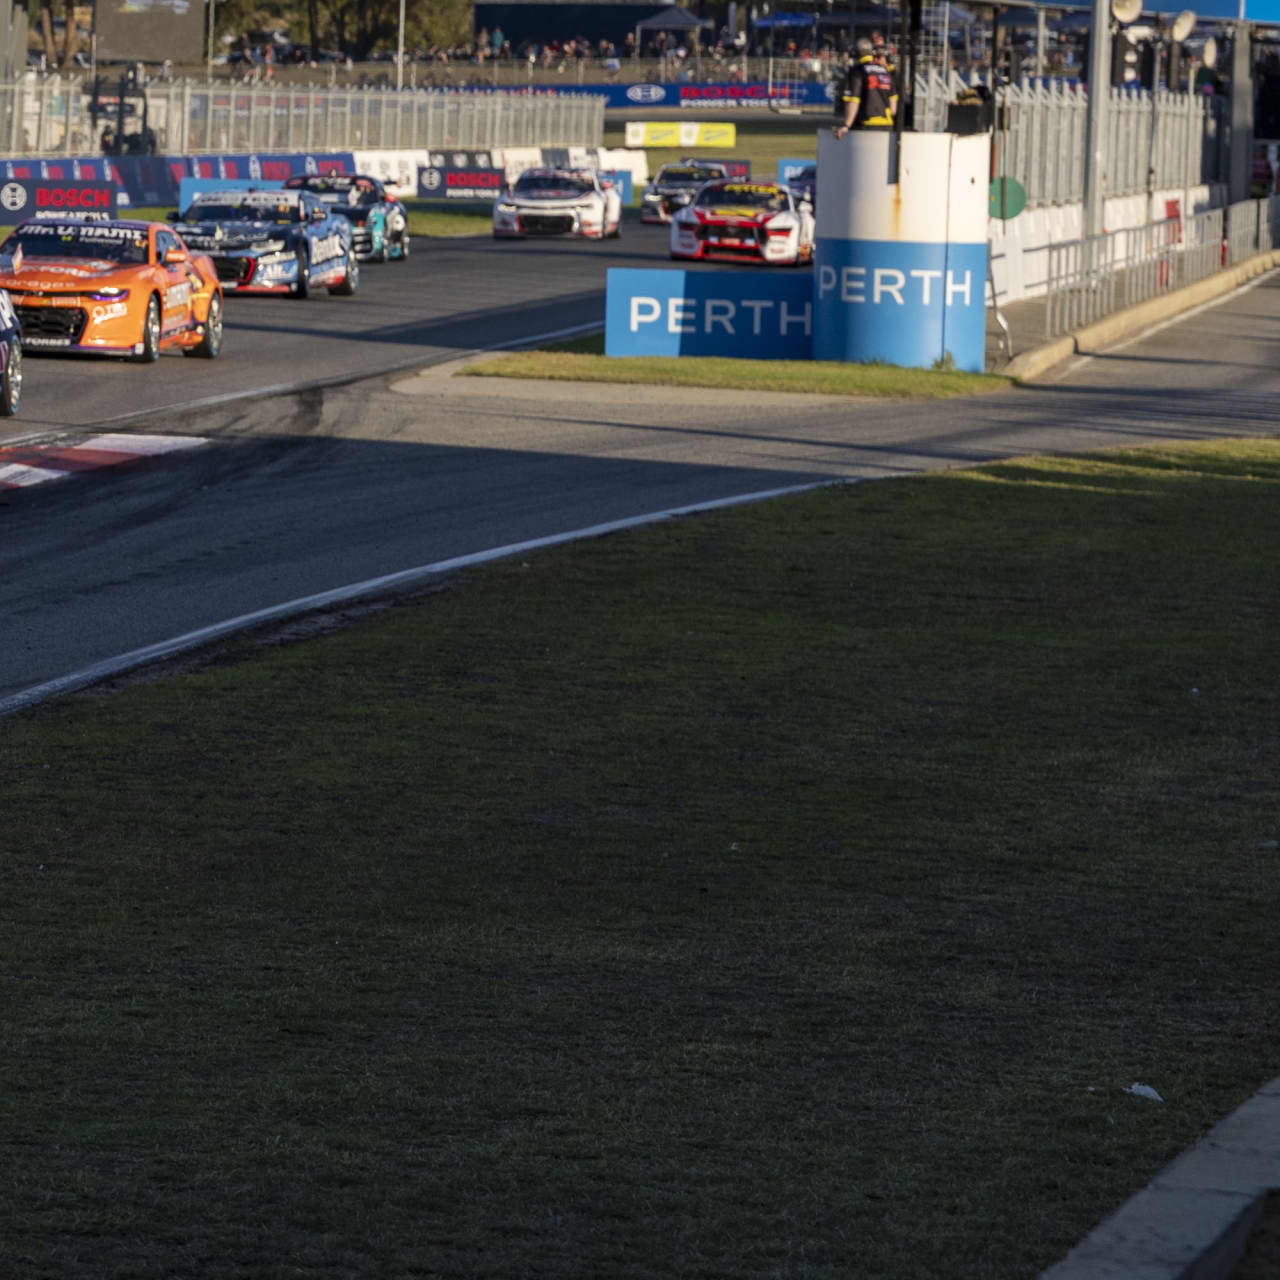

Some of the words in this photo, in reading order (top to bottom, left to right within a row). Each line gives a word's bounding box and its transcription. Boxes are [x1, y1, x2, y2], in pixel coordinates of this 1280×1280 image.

[680, 86, 792, 98] BOSCH
[446, 173, 500, 187] BOSCH
[36, 189, 110, 207] BOSCH
[819, 265, 973, 307] PERTH
[630, 297, 813, 336] PERTH
